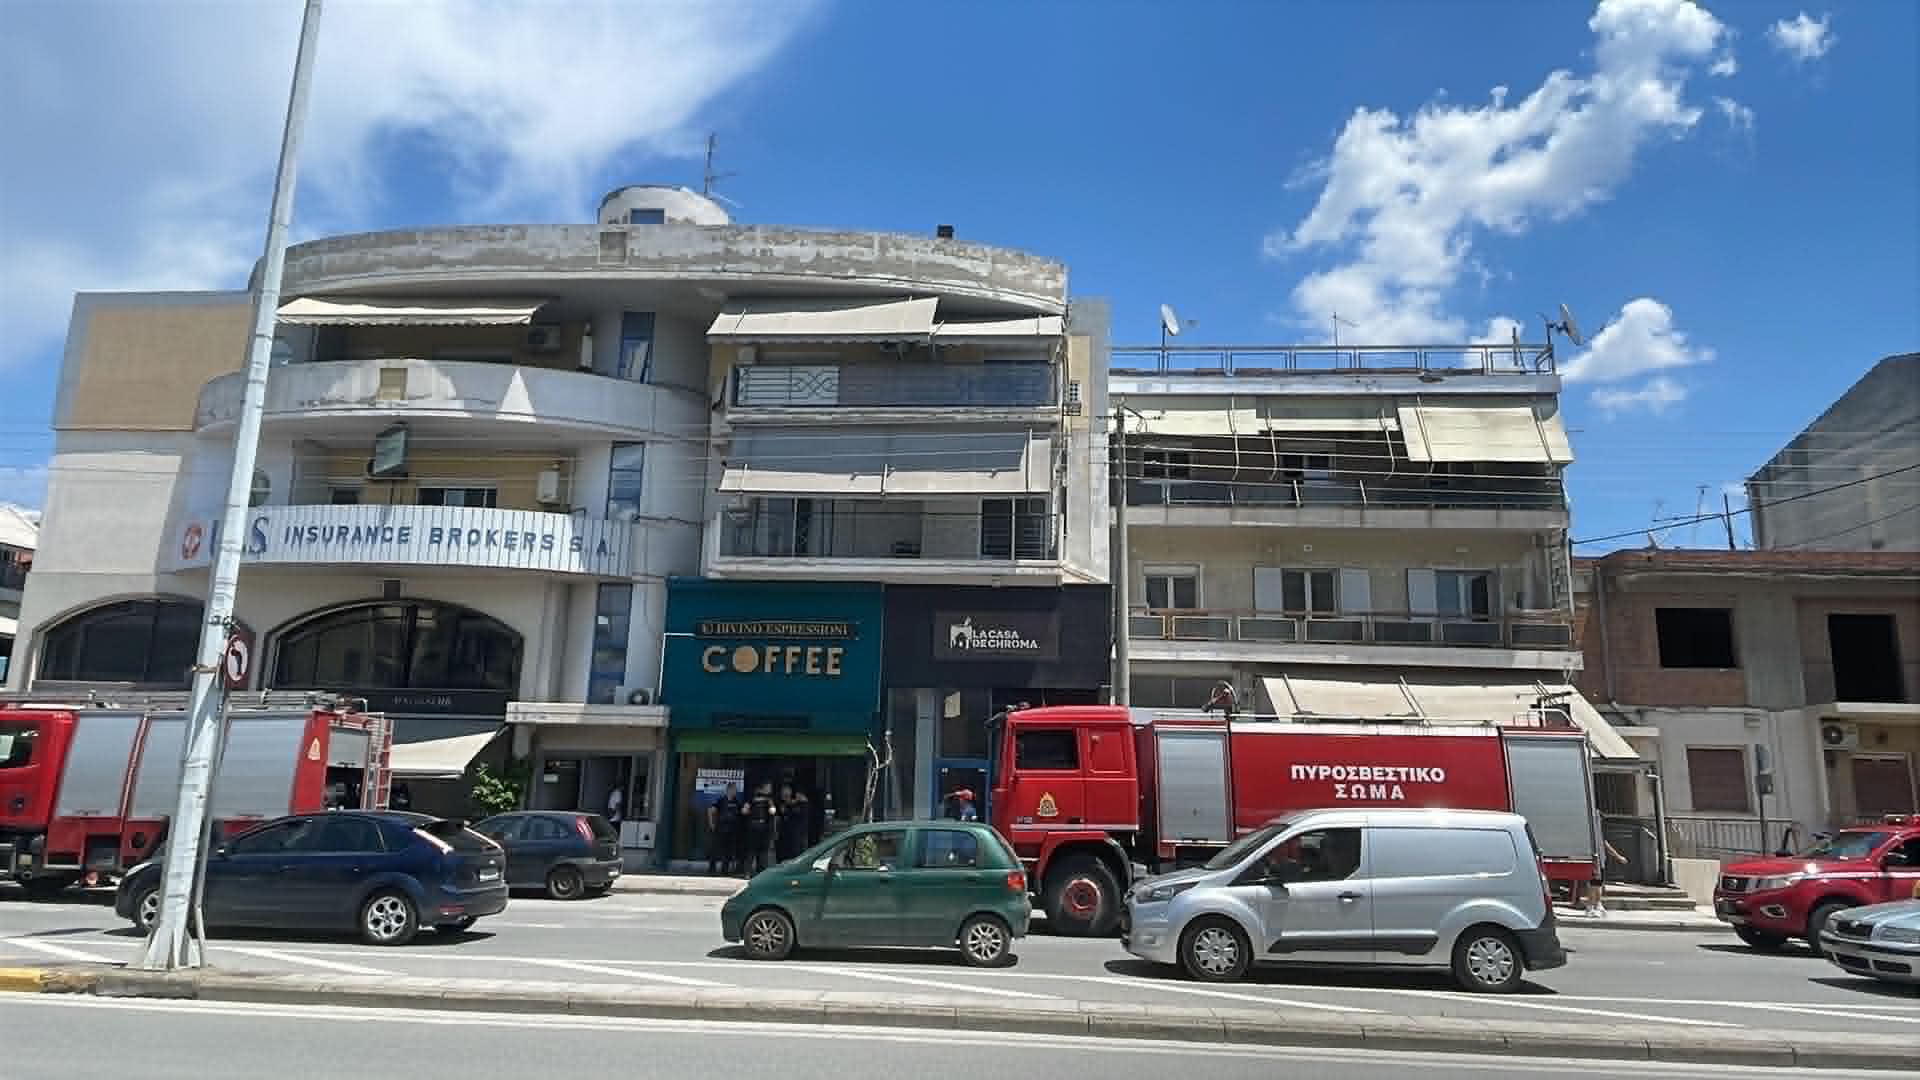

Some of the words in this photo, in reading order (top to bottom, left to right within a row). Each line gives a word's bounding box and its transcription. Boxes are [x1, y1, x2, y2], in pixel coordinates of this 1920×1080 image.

[284, 525, 411, 545] INSURANCE
[429, 527, 555, 552] BROKERS
[702, 646, 844, 675] COFFEE
[1290, 764, 1446, 783] ΠΥΡΟΣΒΕΣΤΙΚΟ
[1334, 783, 1405, 800] ΣΩΜΑ
